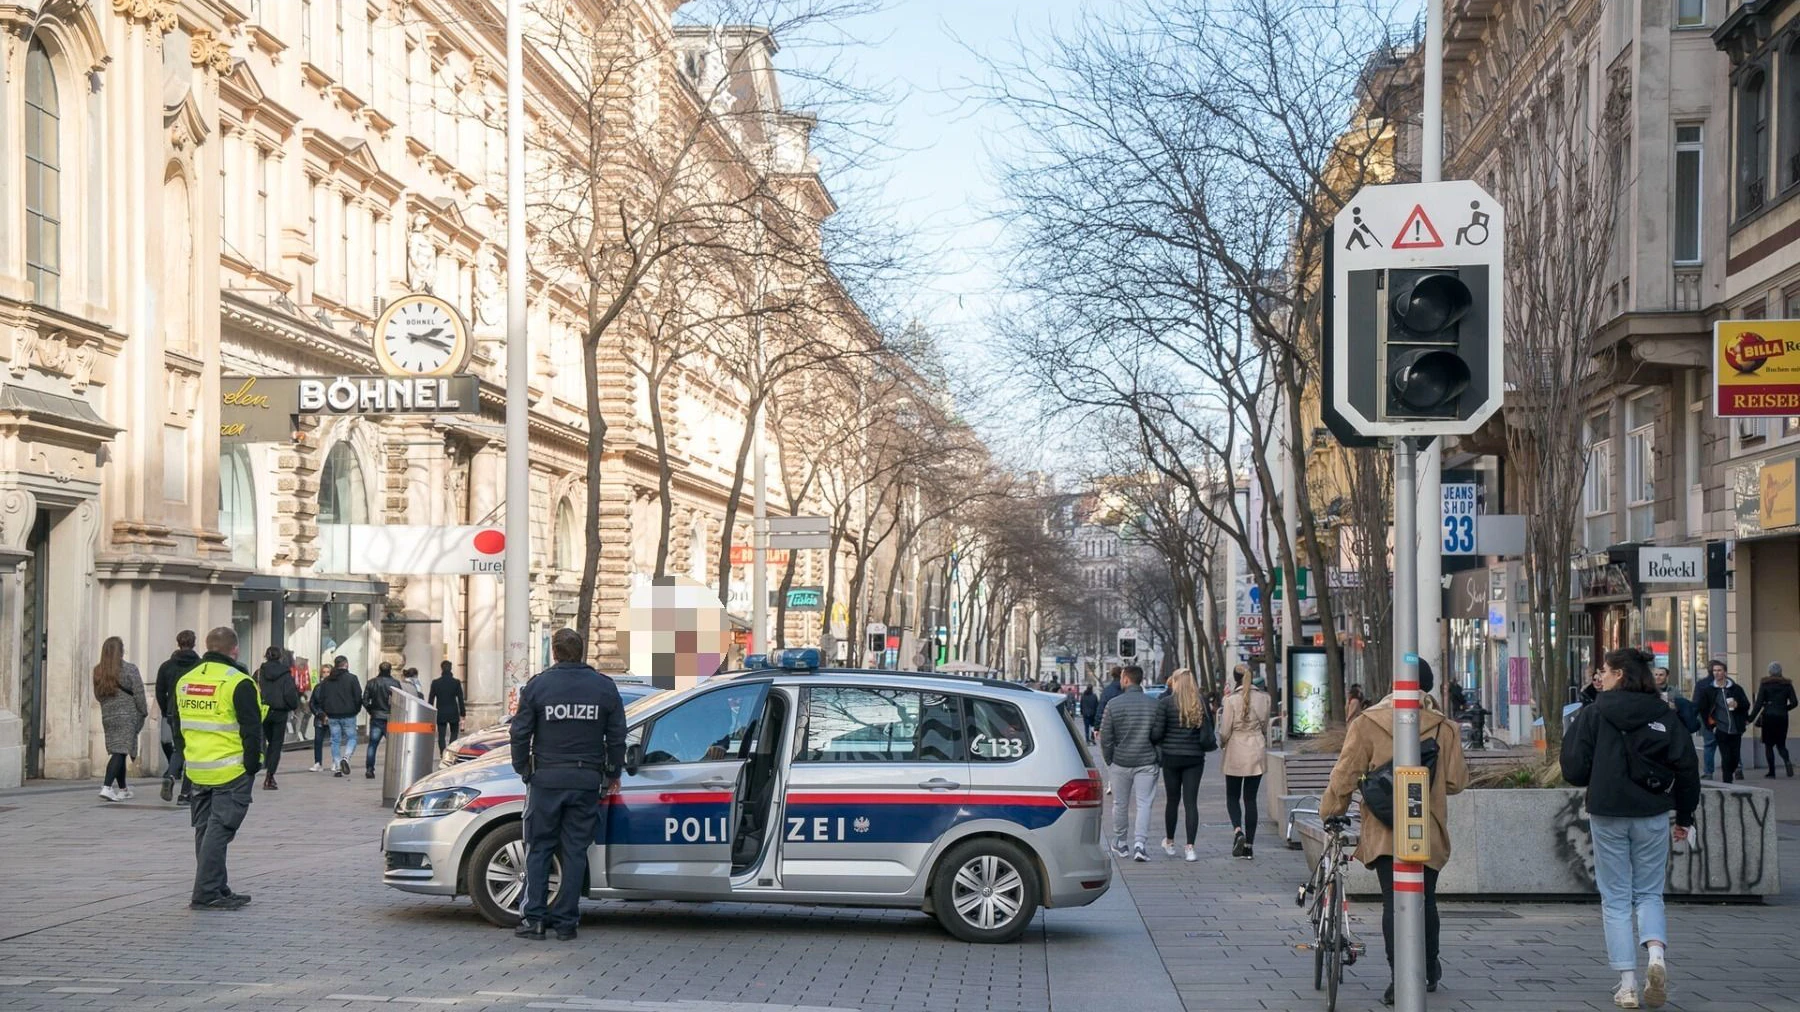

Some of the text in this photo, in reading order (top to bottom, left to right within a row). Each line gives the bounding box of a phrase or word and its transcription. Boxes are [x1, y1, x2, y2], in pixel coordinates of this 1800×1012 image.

[406, 318, 436, 326] BÖHNEL
[1743, 343, 1782, 358] BILLA
[223, 376, 270, 409] elen
[300, 376, 460, 410] BÖHNEL
[1733, 393, 1800, 409] REISEB
[1443, 486, 1474, 500] JEANS
[1443, 501, 1474, 514] SHOP
[1444, 515, 1474, 552] 33
[1648, 561, 1696, 577] Roeckl
[179, 699, 218, 710] UFSICHT
[544, 703, 599, 721] POLIZEI
[988, 738, 1024, 758] 133
